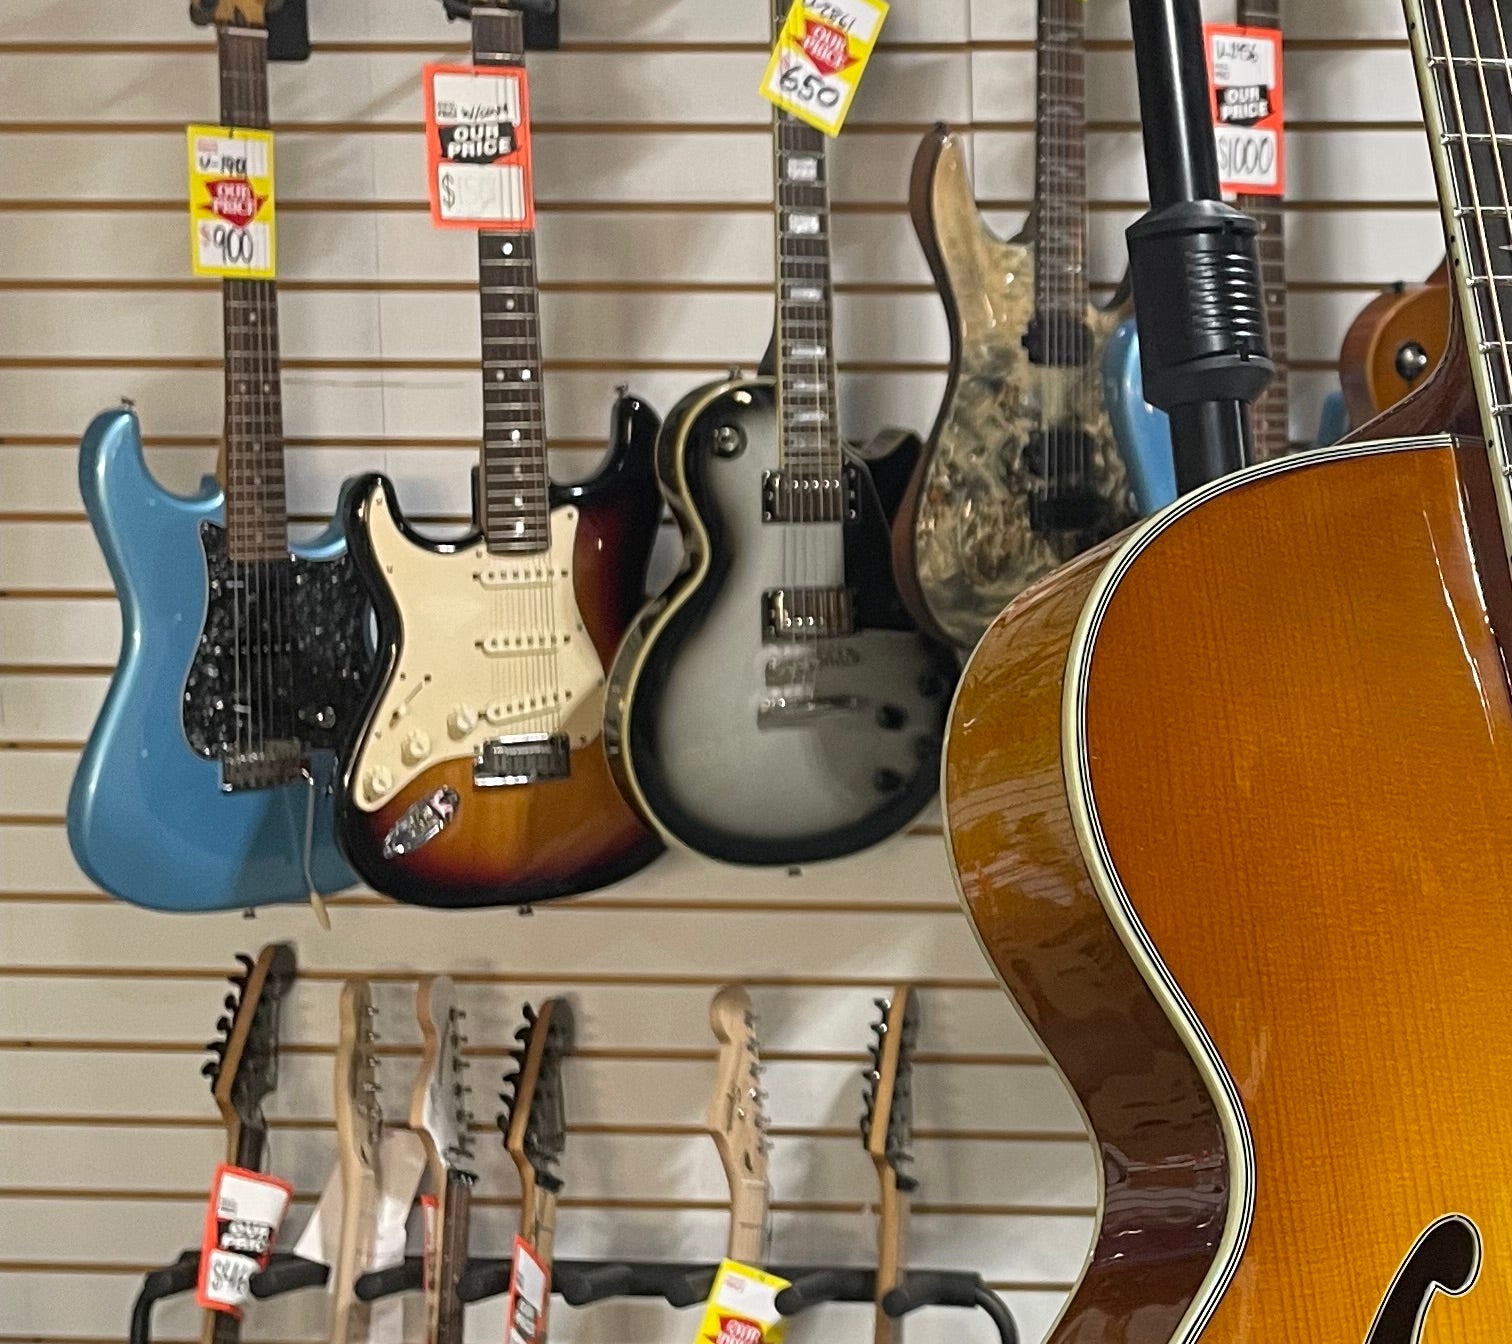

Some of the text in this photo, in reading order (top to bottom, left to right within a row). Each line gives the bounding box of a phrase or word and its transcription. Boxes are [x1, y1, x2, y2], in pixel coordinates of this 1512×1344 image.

[1223, 87, 1261, 106] OUR
[1219, 101, 1270, 123] PRICE
[453, 125, 500, 143] OUR
[447, 136, 512, 160] PRICE
